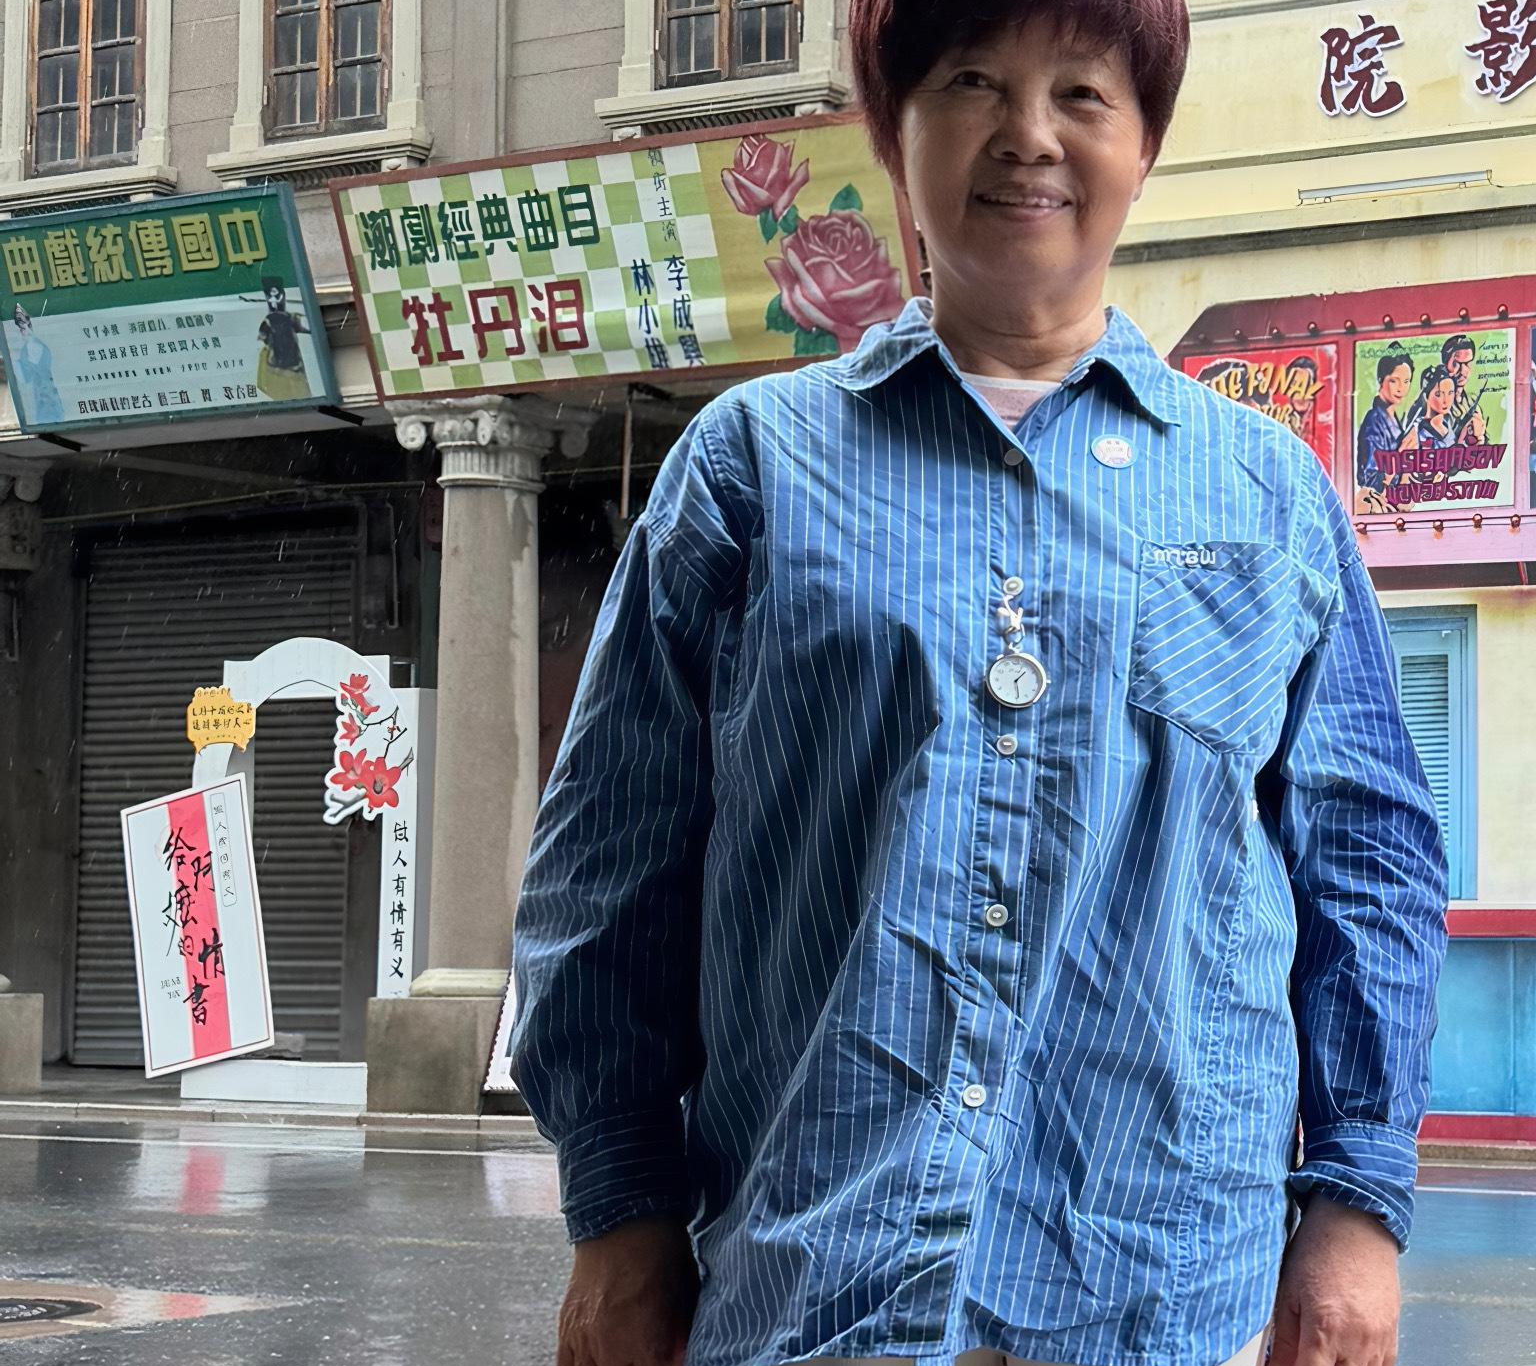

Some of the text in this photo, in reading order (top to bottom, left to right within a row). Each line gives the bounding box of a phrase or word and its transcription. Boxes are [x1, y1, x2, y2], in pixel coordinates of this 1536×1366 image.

[1, 207, 268, 295] 中國傳統戲曲
[358, 183, 601, 271] 潮劇經典曲目
[402, 278, 590, 367] 牡丹泪
